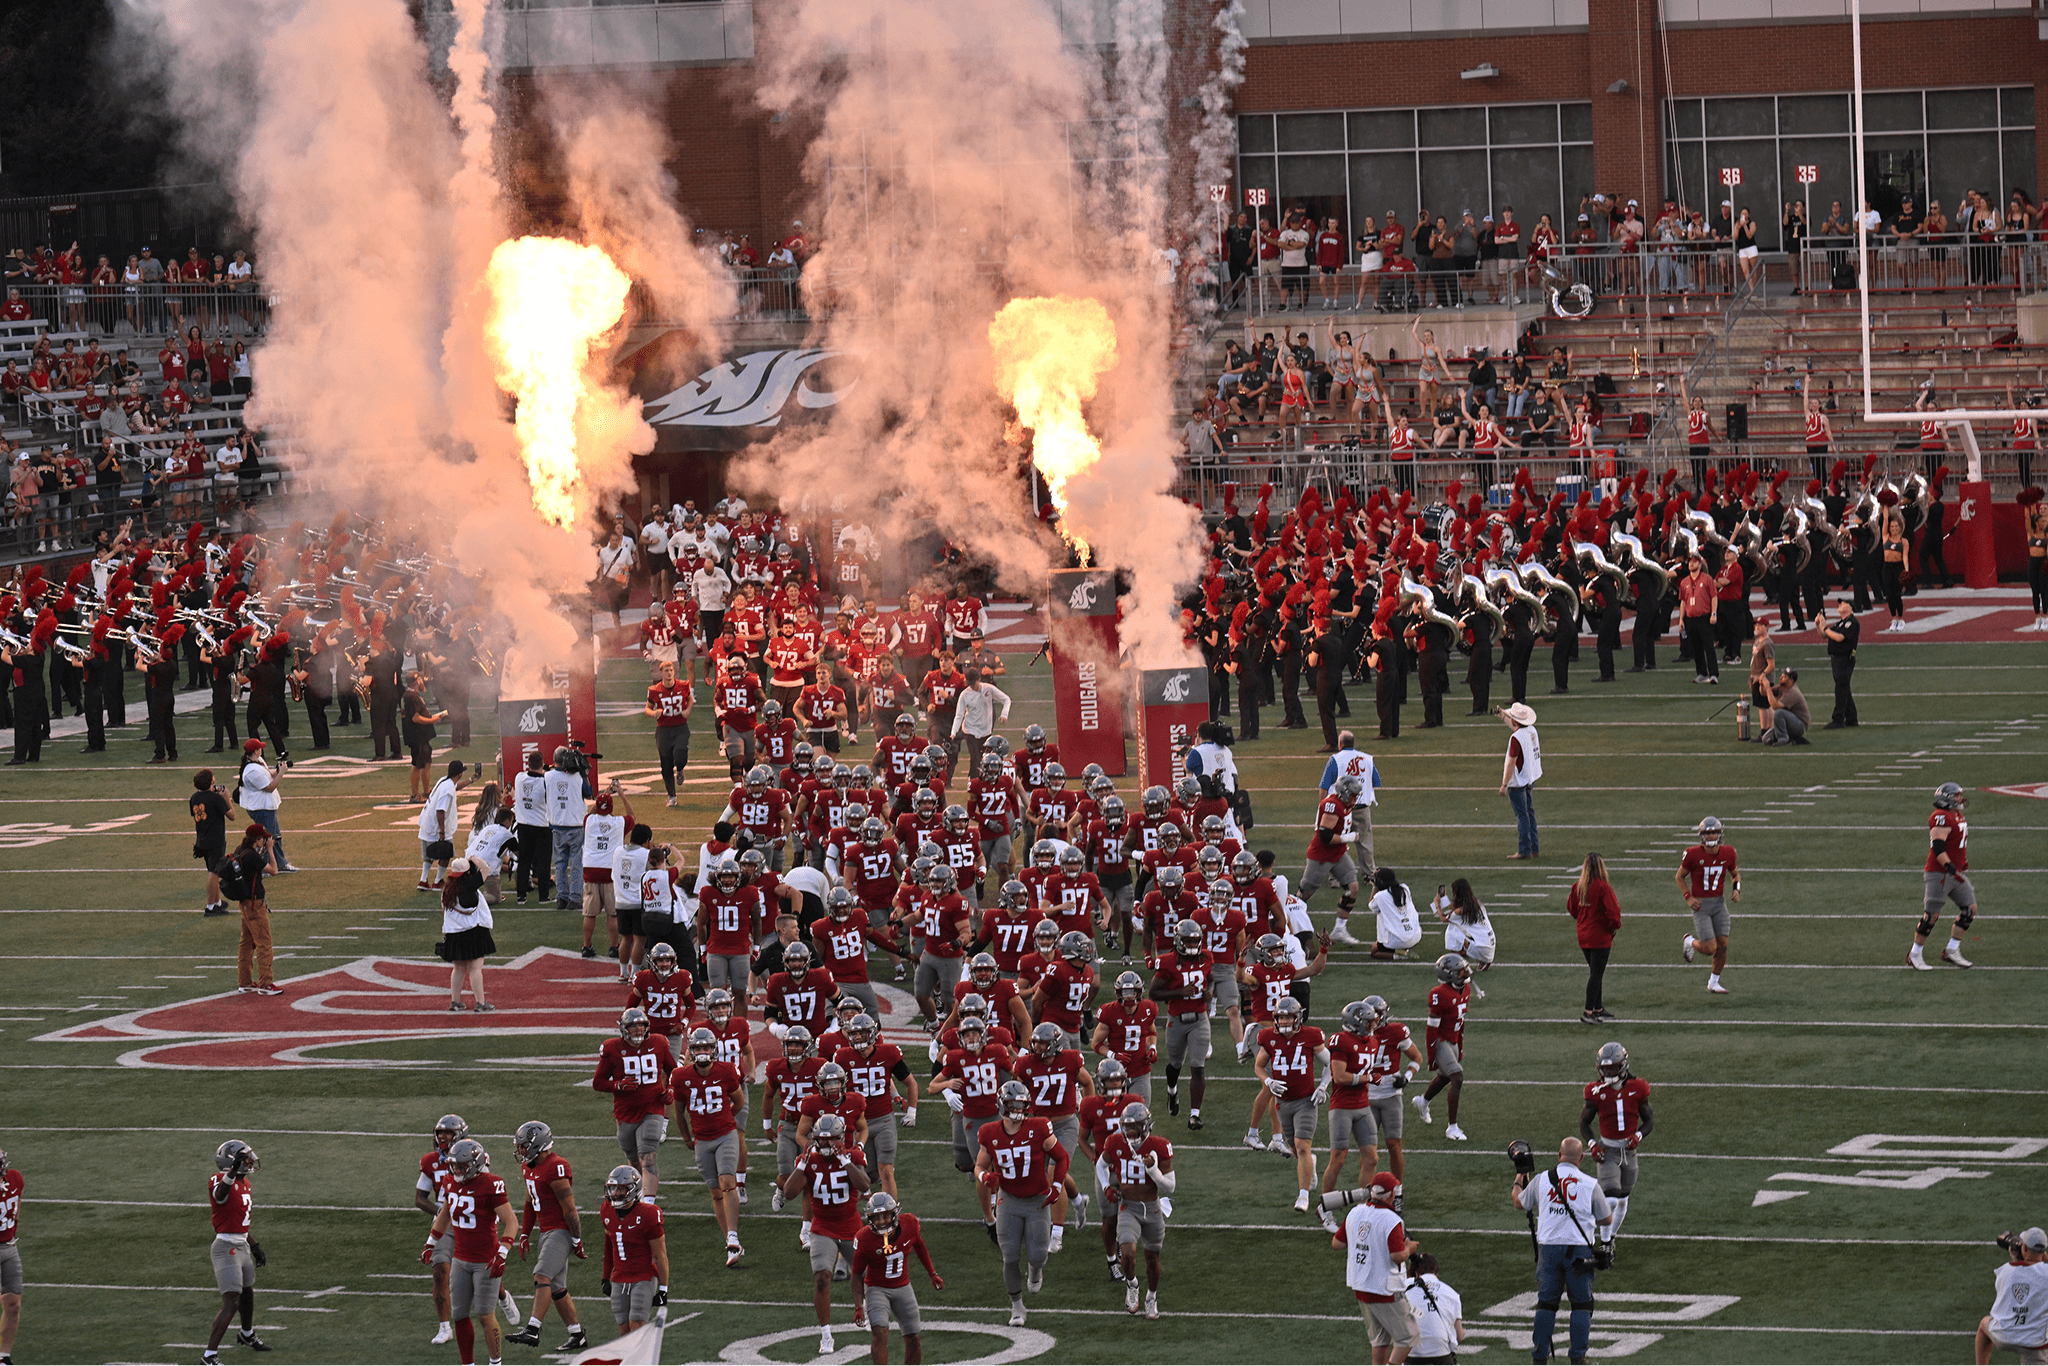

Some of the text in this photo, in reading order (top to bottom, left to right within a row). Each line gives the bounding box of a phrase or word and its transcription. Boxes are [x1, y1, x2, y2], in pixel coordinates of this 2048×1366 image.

[1722, 168, 1741, 185] 36
[1798, 166, 1817, 182] 35
[1210, 185, 1227, 201] 37
[1249, 189, 1266, 205] 36
[841, 565, 859, 581] 80
[954, 611, 974, 628] 24
[906, 624, 926, 644] 57
[777, 651, 799, 670] 73
[661, 696, 683, 717] 63
[725, 688, 747, 708] 66
[873, 687, 895, 708] 82
[1078, 661, 1099, 731] COUGARS
[770, 737, 784, 758] 8
[742, 803, 769, 826] 98
[981, 792, 1007, 815] 22
[863, 852, 891, 880] 52
[947, 843, 975, 868] 65
[1703, 866, 1723, 891] 17
[717, 905, 739, 931] 10
[924, 907, 941, 937] 51
[831, 930, 863, 960] 68
[996, 925, 1029, 952] 77
[1207, 931, 1228, 953] 12
[1066, 982, 1091, 1011] 92
[1181, 970, 1205, 1000] 13
[1265, 979, 1292, 1011] 85
[647, 992, 678, 1018] 23
[783, 991, 816, 1021] 67
[1432, 994, 1439, 1005] 5
[1454, 1002, 1468, 1032] 5
[1329, 1034, 1340, 1047] 21
[622, 1053, 658, 1085] 99
[1273, 1045, 1308, 1076] 44
[851, 1066, 886, 1098] 56
[962, 1062, 997, 1097] 38
[1032, 1073, 1067, 1106] 27
[690, 1085, 723, 1115] 46
[1616, 1099, 1625, 1131] 1
[557, 1164, 565, 1177] 0
[995, 1145, 1032, 1180] 97
[1119, 1158, 1146, 1184] 19
[813, 1170, 850, 1205] 45
[241, 1193, 252, 1227] 2
[447, 1192, 477, 1229] 23
[636, 1216, 641, 1224] C
[656, 1209, 661, 1223] 1
[615, 1231, 627, 1262] 1
[1355, 1253, 1366, 1265] 62
[885, 1251, 904, 1279] 0
[2014, 1315, 2026, 1325] 73
